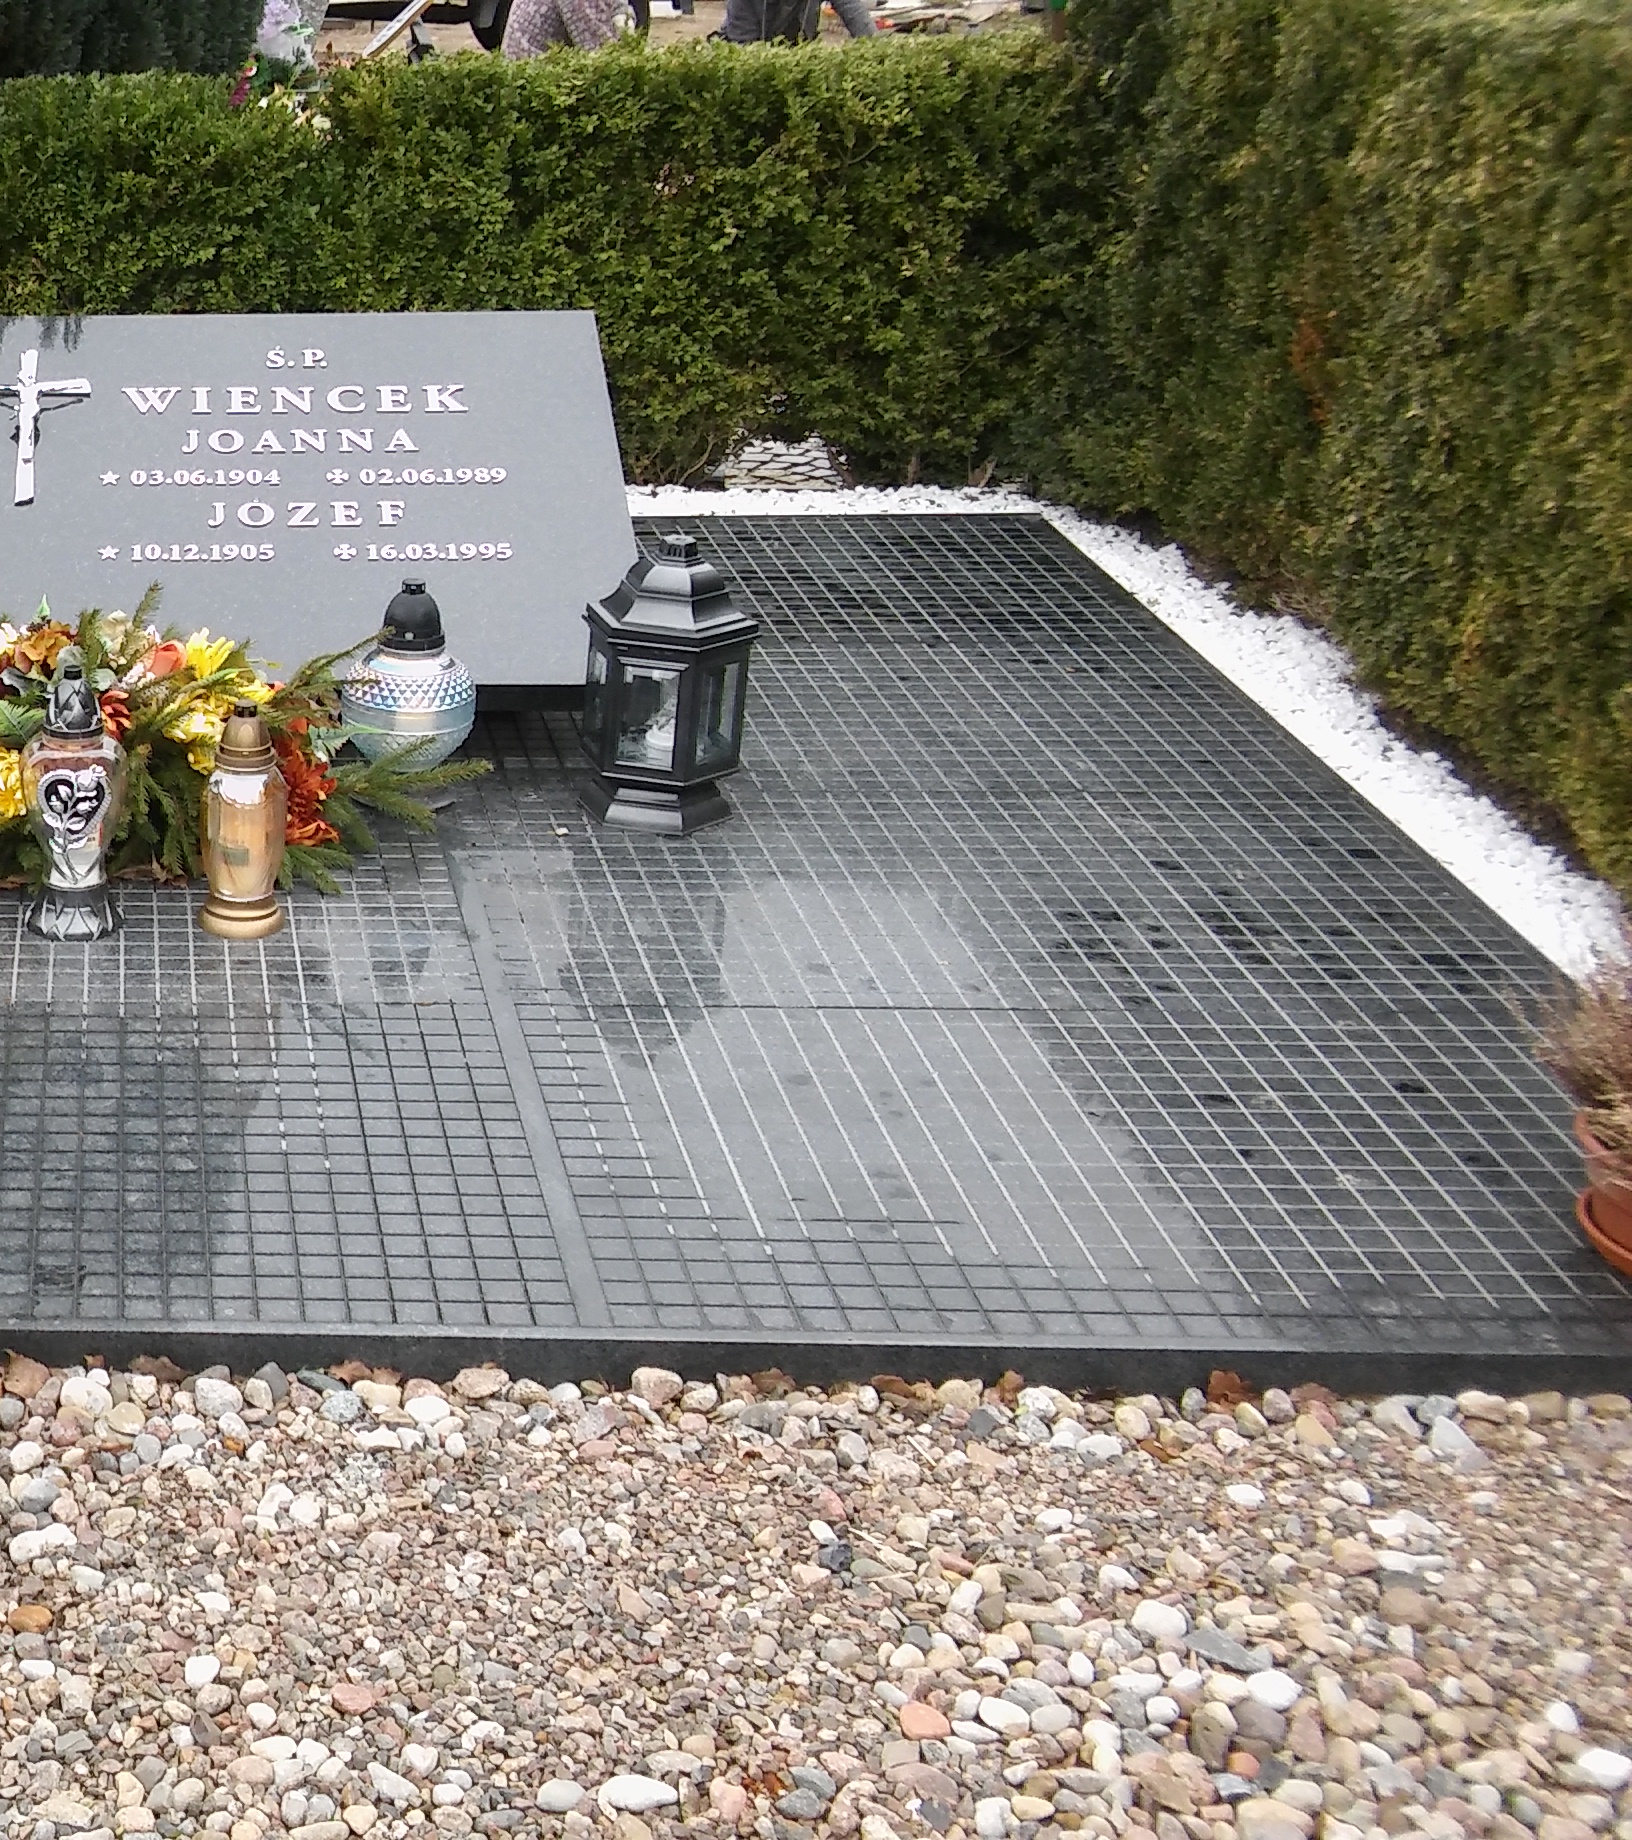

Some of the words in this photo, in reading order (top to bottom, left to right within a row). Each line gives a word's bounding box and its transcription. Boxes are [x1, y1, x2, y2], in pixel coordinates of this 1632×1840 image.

[121, 384, 469, 413] WIENCEK
[181, 428, 420, 452] JOANNA
[129, 469, 281, 485] 03.06.1904
[358, 467, 508, 484] 02.06.1989
[207, 498, 407, 527] JÓZEF
[130, 544, 275, 561] 10.12.1905
[366, 543, 513, 560] 16.03.1995
